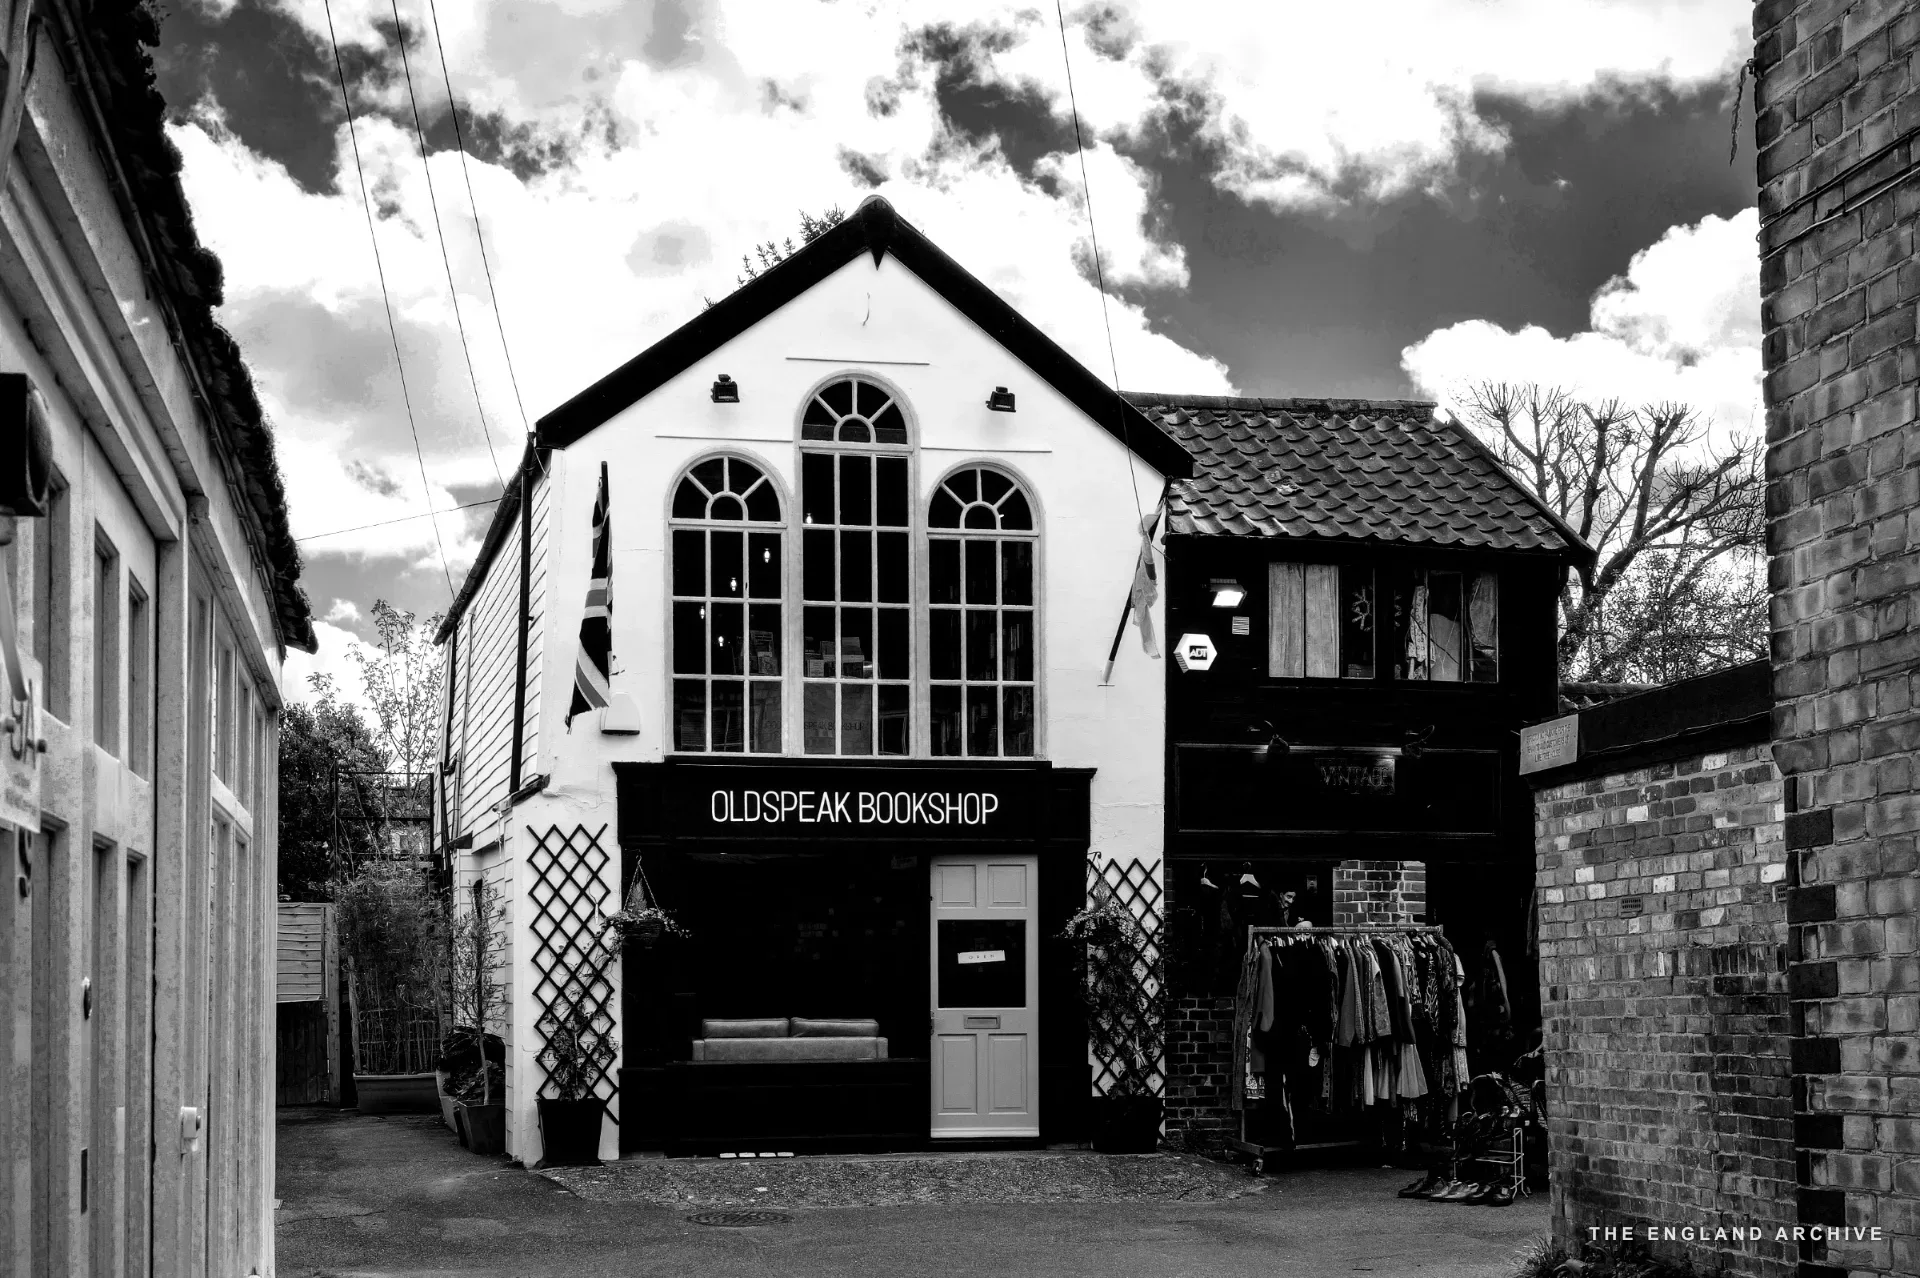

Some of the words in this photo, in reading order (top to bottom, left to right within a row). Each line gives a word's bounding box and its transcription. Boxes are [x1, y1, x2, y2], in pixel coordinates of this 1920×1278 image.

[1189, 647, 1208, 658] ADT
[711, 790, 852, 823] OLDSPEAK
[859, 792, 999, 825] BOOKSHOP
